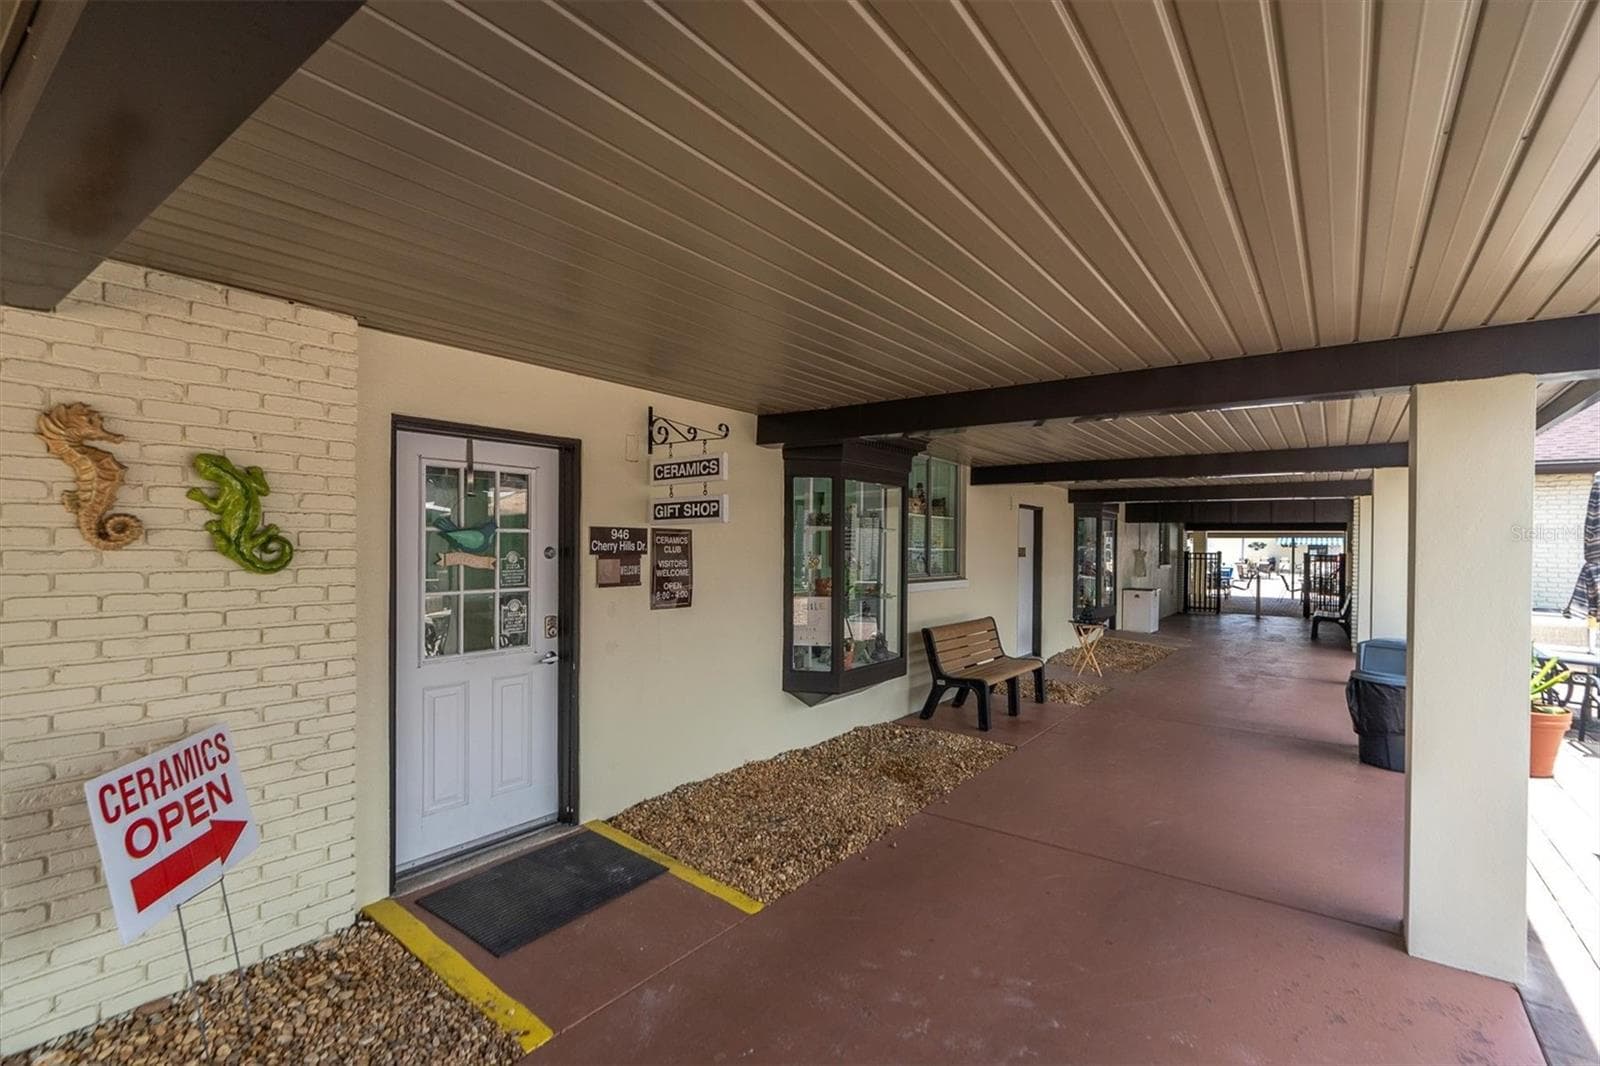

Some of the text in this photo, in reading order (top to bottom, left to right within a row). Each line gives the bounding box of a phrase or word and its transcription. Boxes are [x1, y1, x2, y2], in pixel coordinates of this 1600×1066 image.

[655, 460, 718, 479] CERAMICS
[655, 502, 719, 518] GIFT SHOP
[611, 528, 630, 540] 946
[656, 536, 688, 545] CERAMICS
[591, 540, 647, 554] Cherry Hills Dr.
[663, 545, 682, 554] CLUB
[657, 559, 688, 568] VISITORS
[656, 568, 690, 577] WELCOME
[663, 581, 682, 591] OPEN
[98, 732, 231, 825] CERAMICS
[124, 773, 234, 860] OPEN
